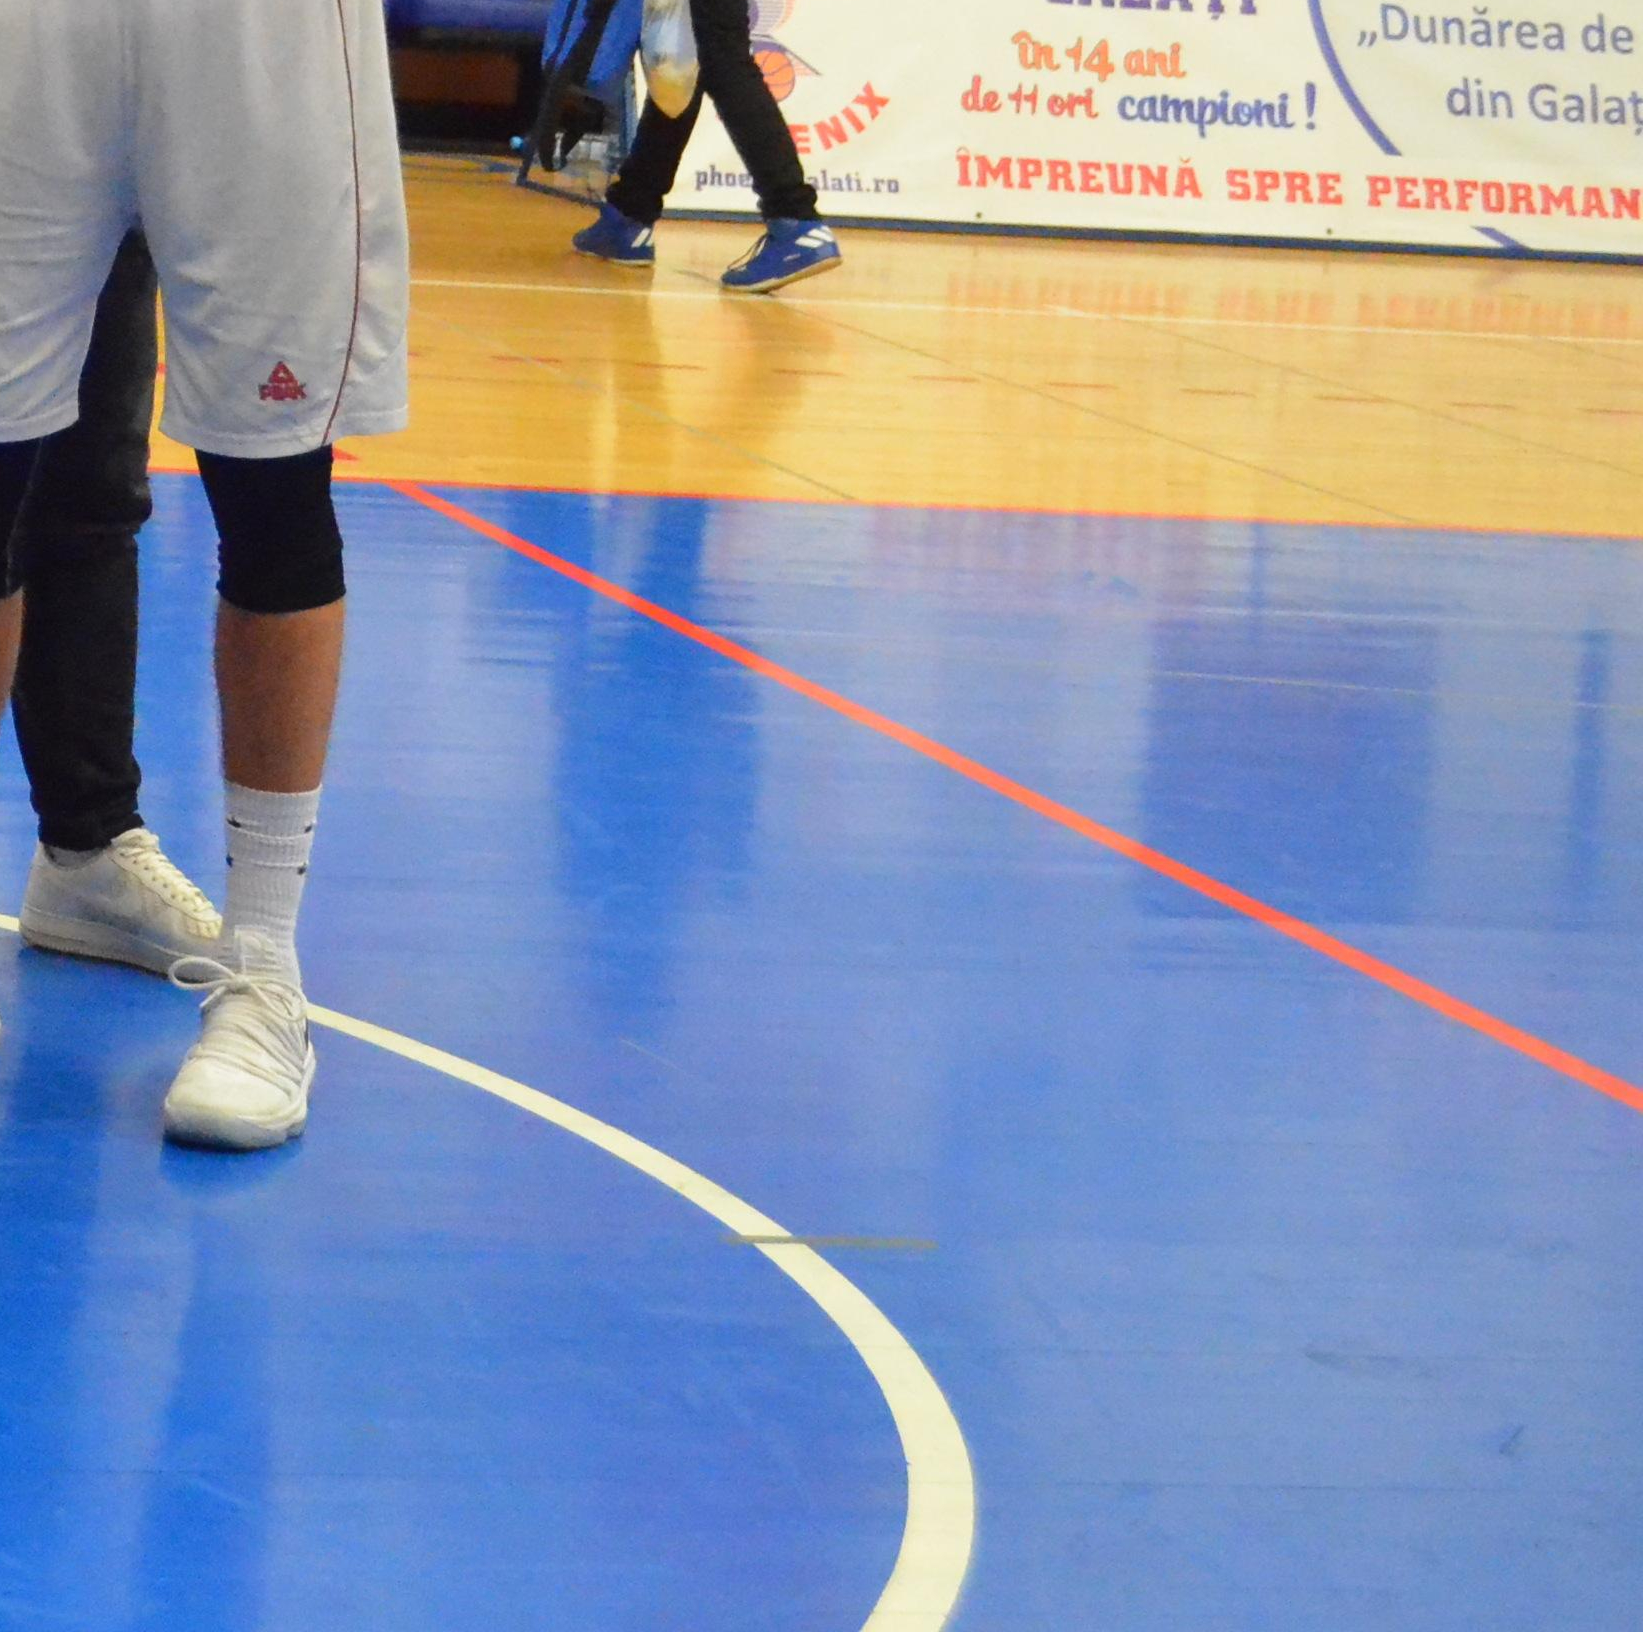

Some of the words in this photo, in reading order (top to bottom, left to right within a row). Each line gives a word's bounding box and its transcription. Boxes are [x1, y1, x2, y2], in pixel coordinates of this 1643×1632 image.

[1011, 30, 1060, 72] în
[1066, 36, 1115, 83] 14
[1123, 42, 1187, 79] ani
[1581, 13, 1634, 55] de
[960, 74, 1001, 113] de
[1047, 87, 1099, 120] ori
[1117, 89, 1296, 139] campioni
[1446, 77, 1514, 119] din
[695, 164, 900, 195] phoealati.ro
[955, 146, 1204, 200] ÎMPREUNĂ
[1225, 168, 1345, 206] SPRE
[1366, 175, 1643, 221] PERFORMAN
